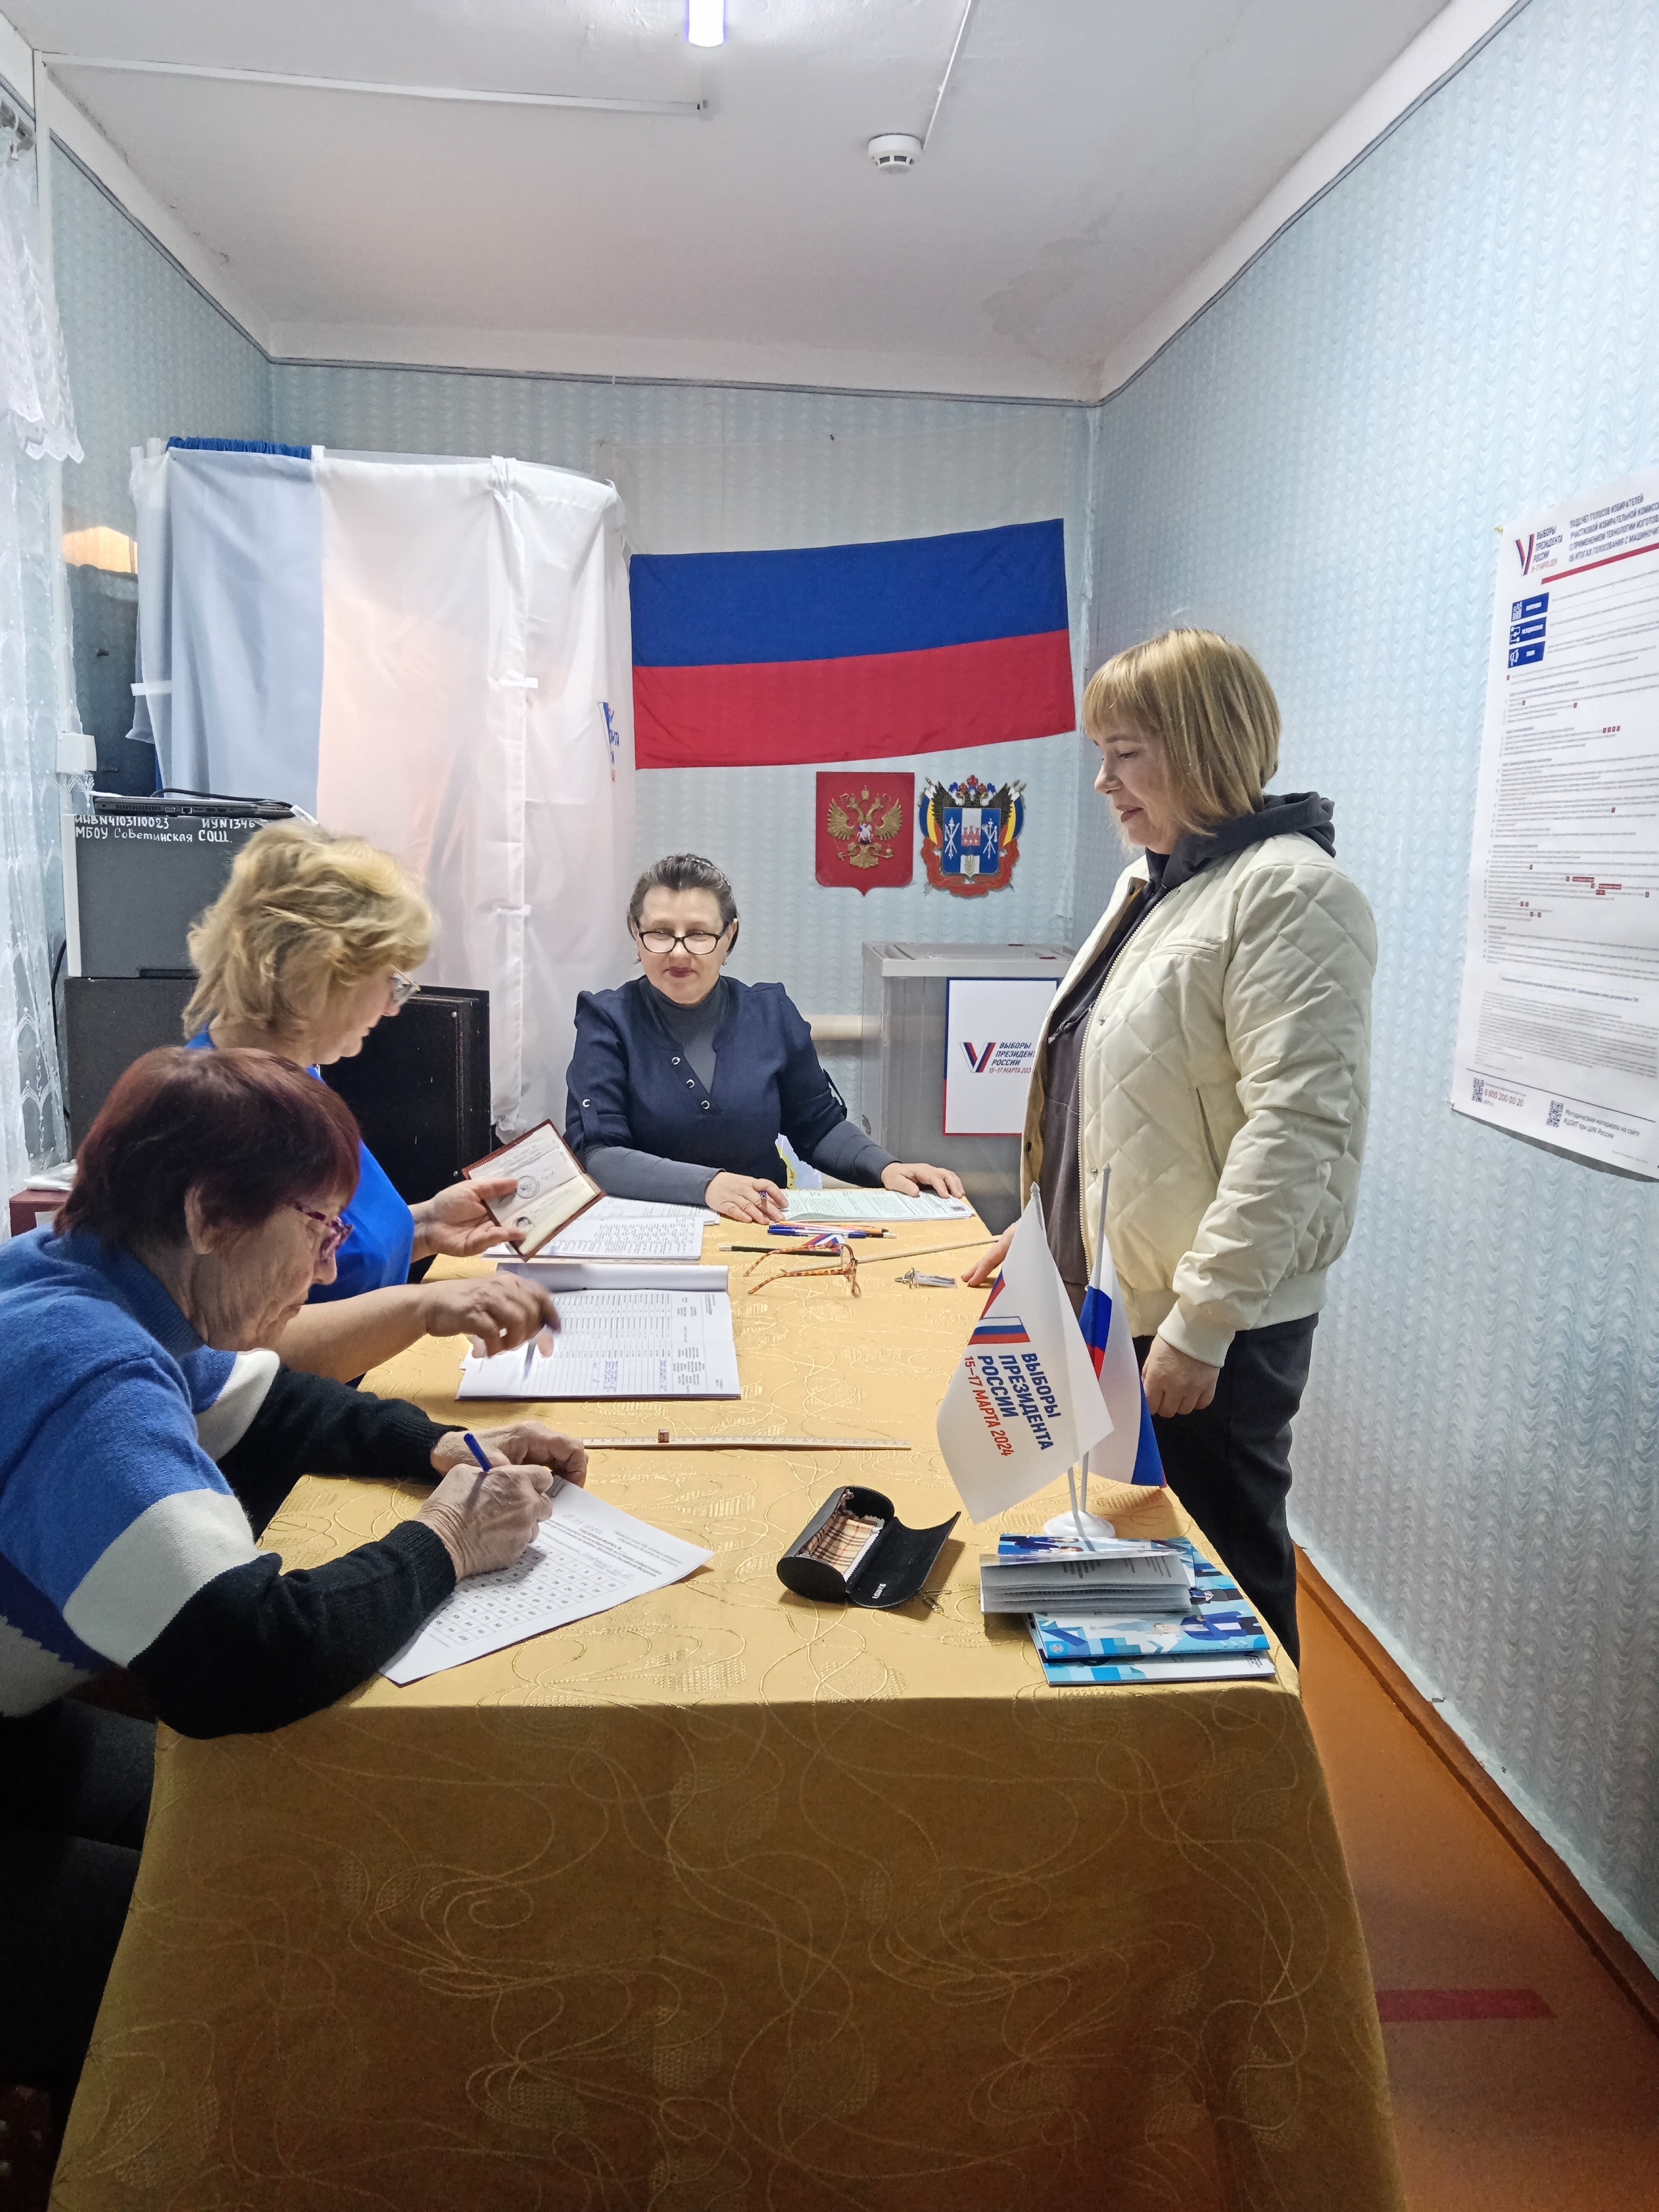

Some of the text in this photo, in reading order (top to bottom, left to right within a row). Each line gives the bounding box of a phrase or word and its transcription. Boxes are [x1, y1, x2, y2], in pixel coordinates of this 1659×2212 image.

[1611, 493, 1643, 513] ИЗБИРАТЕЛЕЙ
[1599, 508, 1637, 529] ИЗБИРАТЕЛЬНОЙ
[1638, 501, 1659, 516] КОМИСС
[1636, 514, 1659, 529] ИЗГОТОВ
[1537, 526, 1556, 540] ВЫБОРЫ
[1535, 535, 1562, 551] ПРЕЗИДЕНТА
[1533, 550, 1550, 563] РОССИИ
[76, 826, 108, 839] МБОУ
[1488, 1090, 1498, 1099] 800
[1498, 1093, 1508, 1102] 200
[1509, 1096, 1516, 1104] 00
[1517, 1099, 1523, 1107] 20
[1566, 1109, 1596, 1123] Методические
[1596, 1119, 1620, 1131] материалы
[1627, 1129, 1640, 1137] сайте
[1587, 1125, 1597, 1133] ЦИК
[1598, 1128, 1614, 1139] России
[977, 1356, 1019, 1417] РОССИИ
[1021, 1353, 1062, 1418] ВЫБОРЫ
[998, 1355, 1054, 1450] ПРЕЗИДЕНТА
[972, 1389, 1001, 1428] МАРТА
[990, 1430, 1014, 1456] 2024
